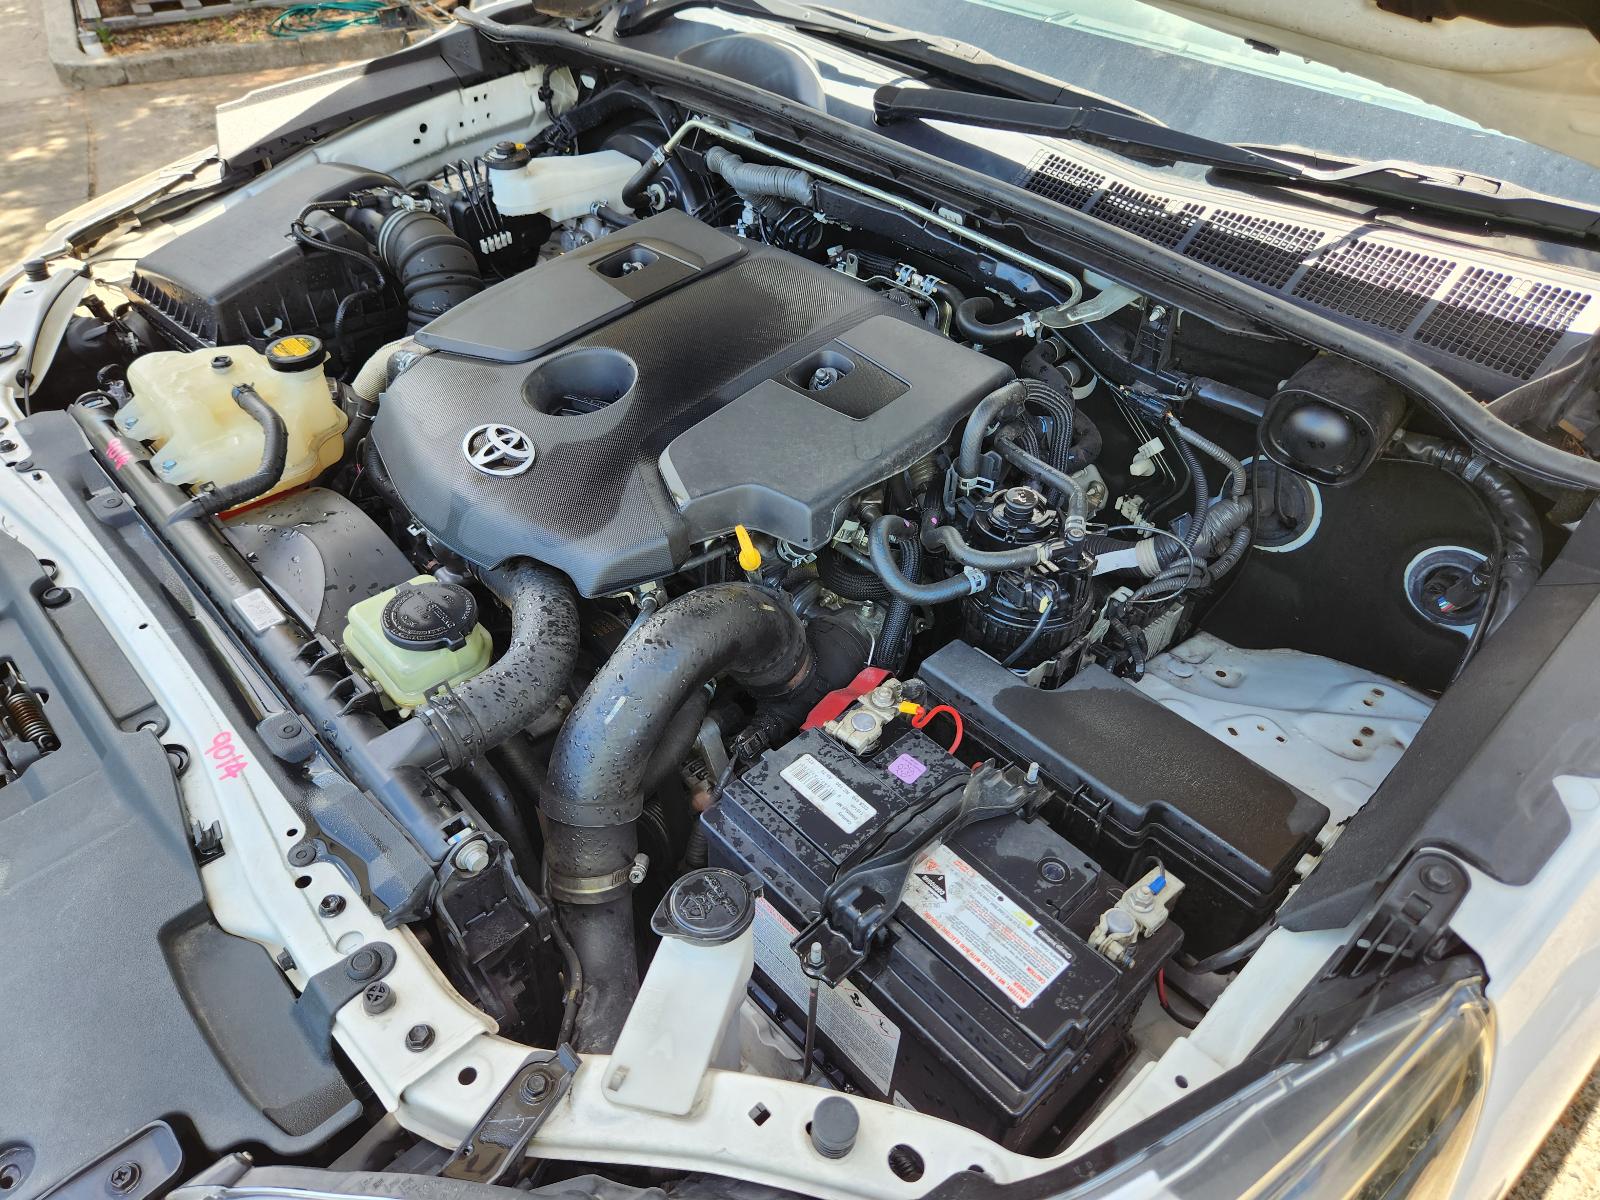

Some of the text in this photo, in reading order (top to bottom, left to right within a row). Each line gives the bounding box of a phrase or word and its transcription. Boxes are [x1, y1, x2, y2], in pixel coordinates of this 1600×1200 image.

[204, 731, 249, 780] 9014
[921, 873, 945, 896] CORROSIVE
[967, 951, 981, 963] WITH
[979, 961, 995, 976] FILLED
